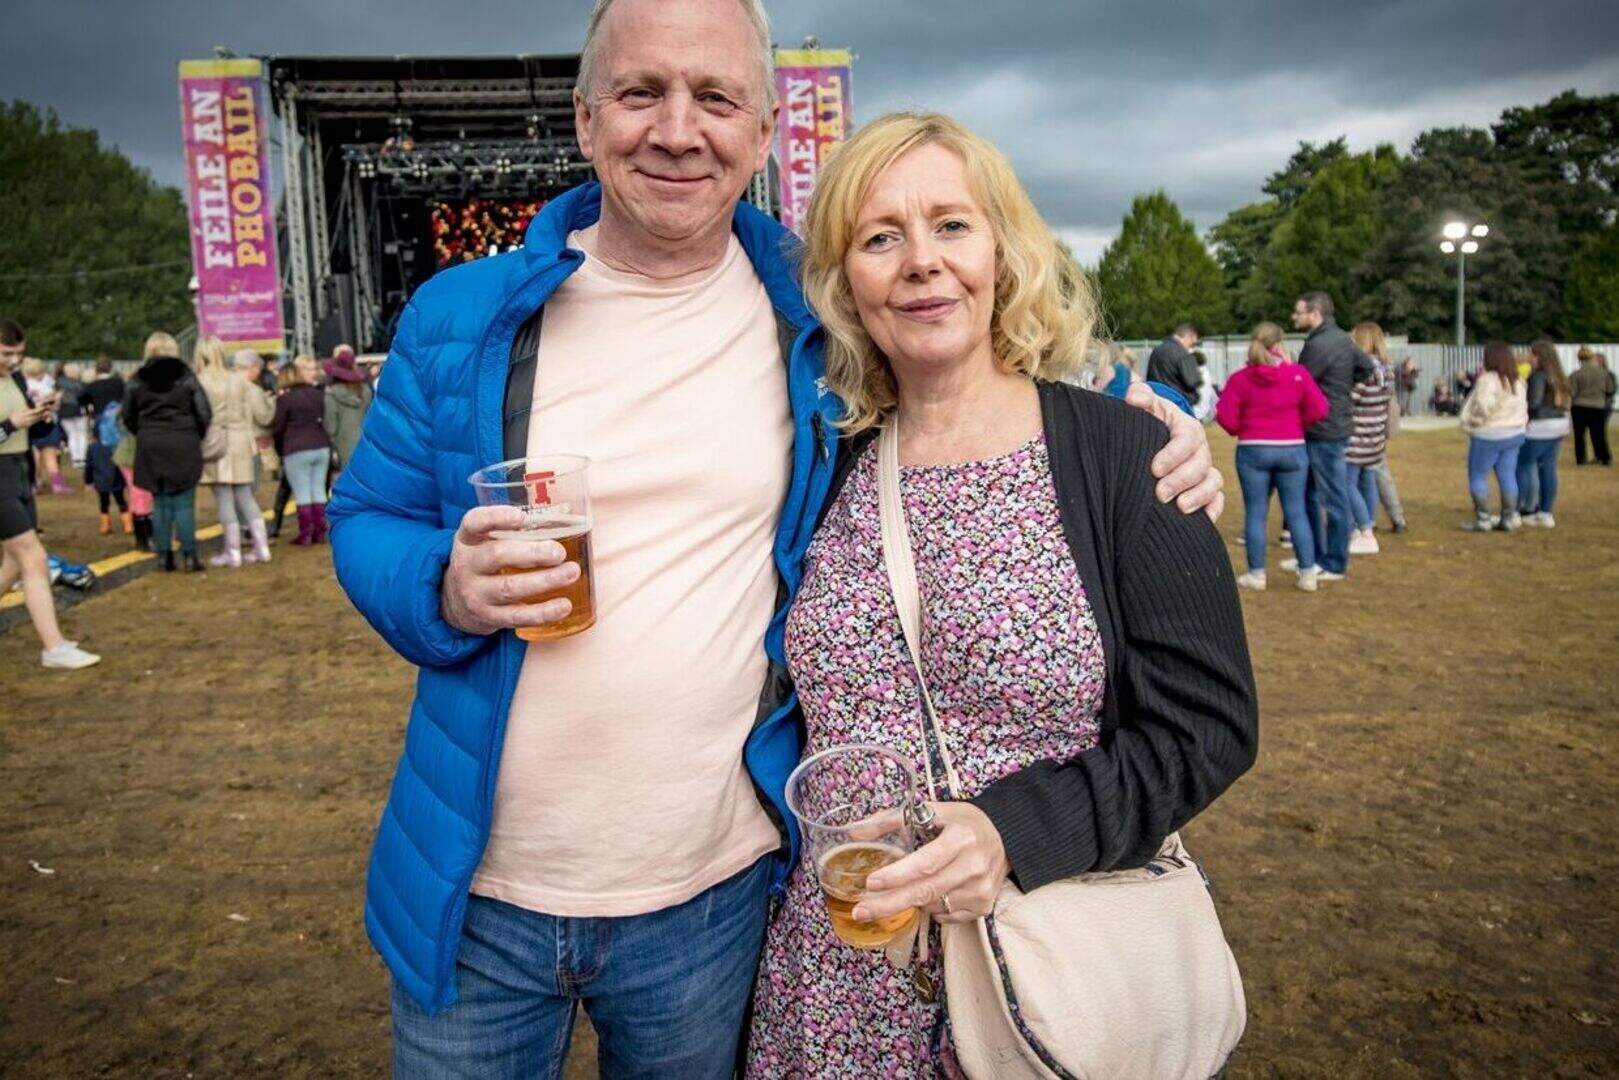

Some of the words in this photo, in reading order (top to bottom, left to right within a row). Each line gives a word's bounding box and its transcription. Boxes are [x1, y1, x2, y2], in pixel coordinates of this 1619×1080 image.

[192, 89, 225, 145] AN
[786, 77, 815, 129] AN
[816, 75, 844, 167] BAIL
[196, 154, 234, 269] FÉILE
[225, 86, 267, 268] PHOBAIL
[785, 138, 817, 226] ÉILE
[525, 471, 555, 504] T
